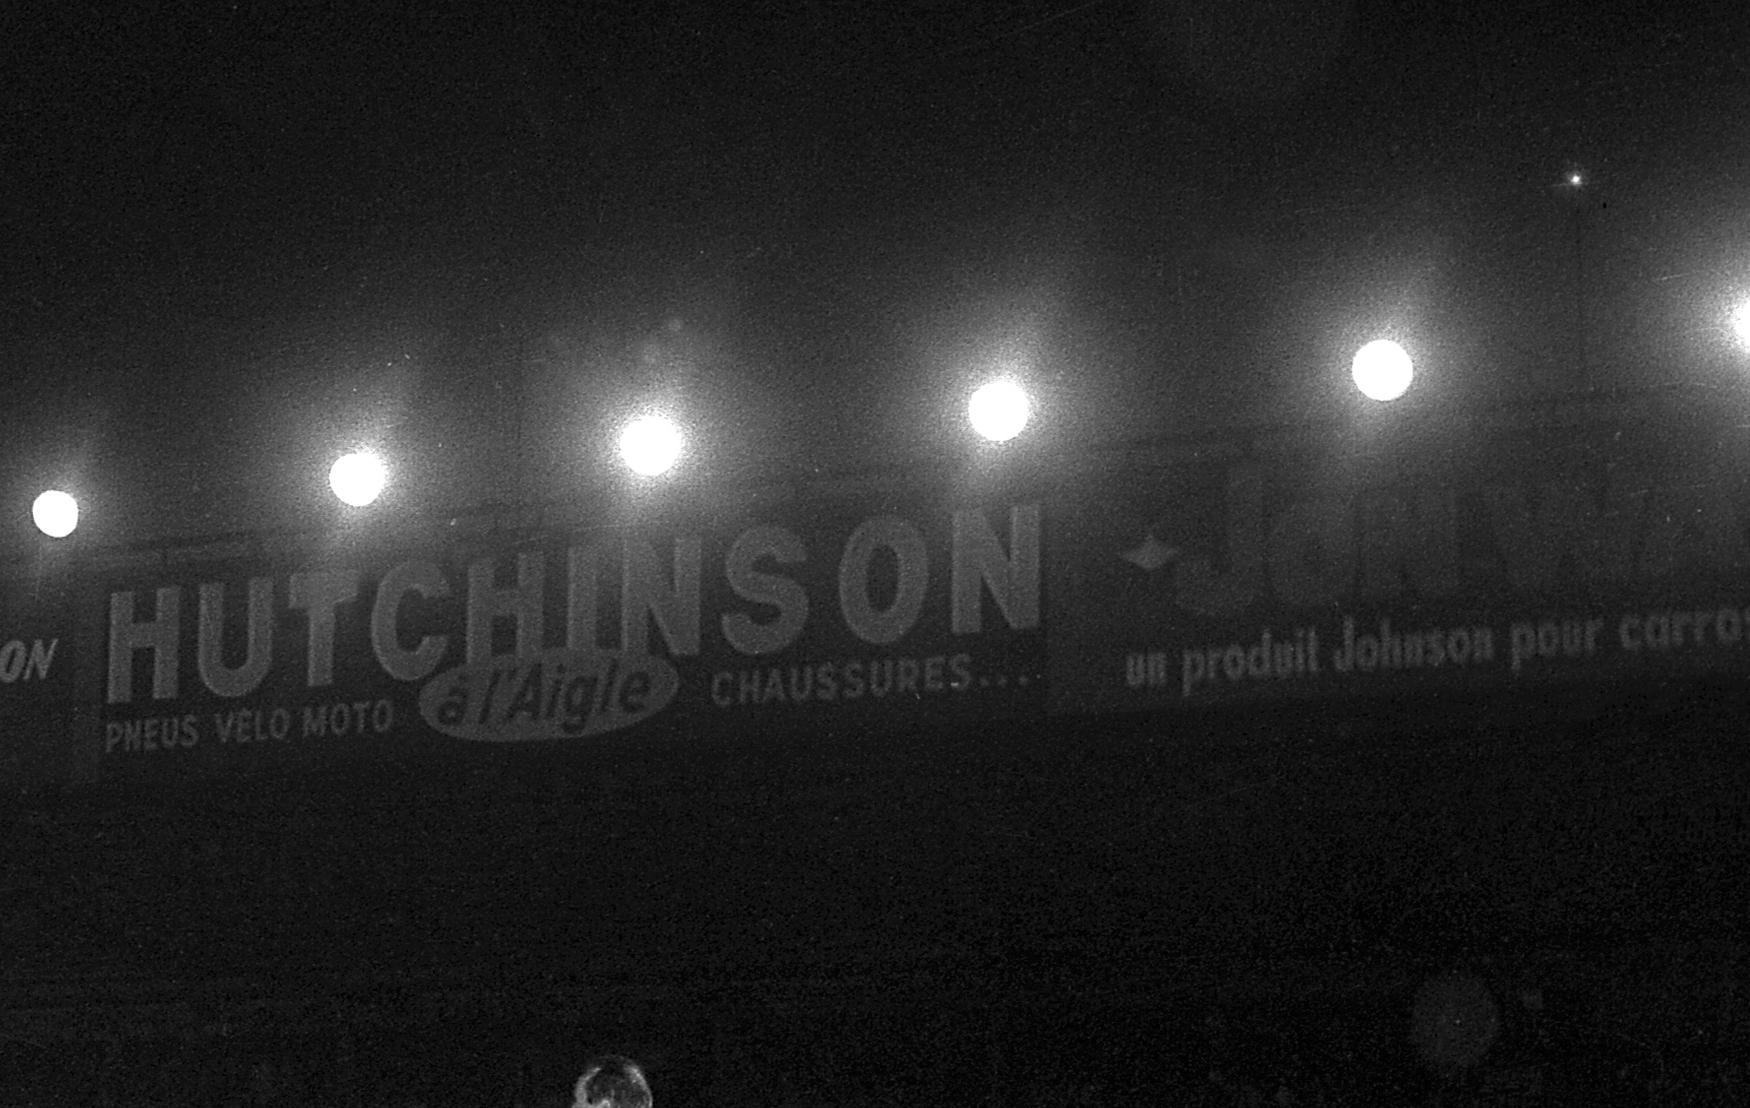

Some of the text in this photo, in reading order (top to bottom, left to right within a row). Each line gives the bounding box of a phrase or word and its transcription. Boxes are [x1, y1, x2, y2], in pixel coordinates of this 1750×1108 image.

[107, 503, 1043, 705] HUTCHINSON
[1126, 649, 1167, 688] un
[1181, 627, 1320, 697] produit
[1333, 613, 1495, 673] Johnson
[1510, 612, 1604, 674] pour
[105, 714, 199, 754] PNEUS
[302, 698, 394, 738] MOTO
[477, 658, 651, 735] l'Aigle
